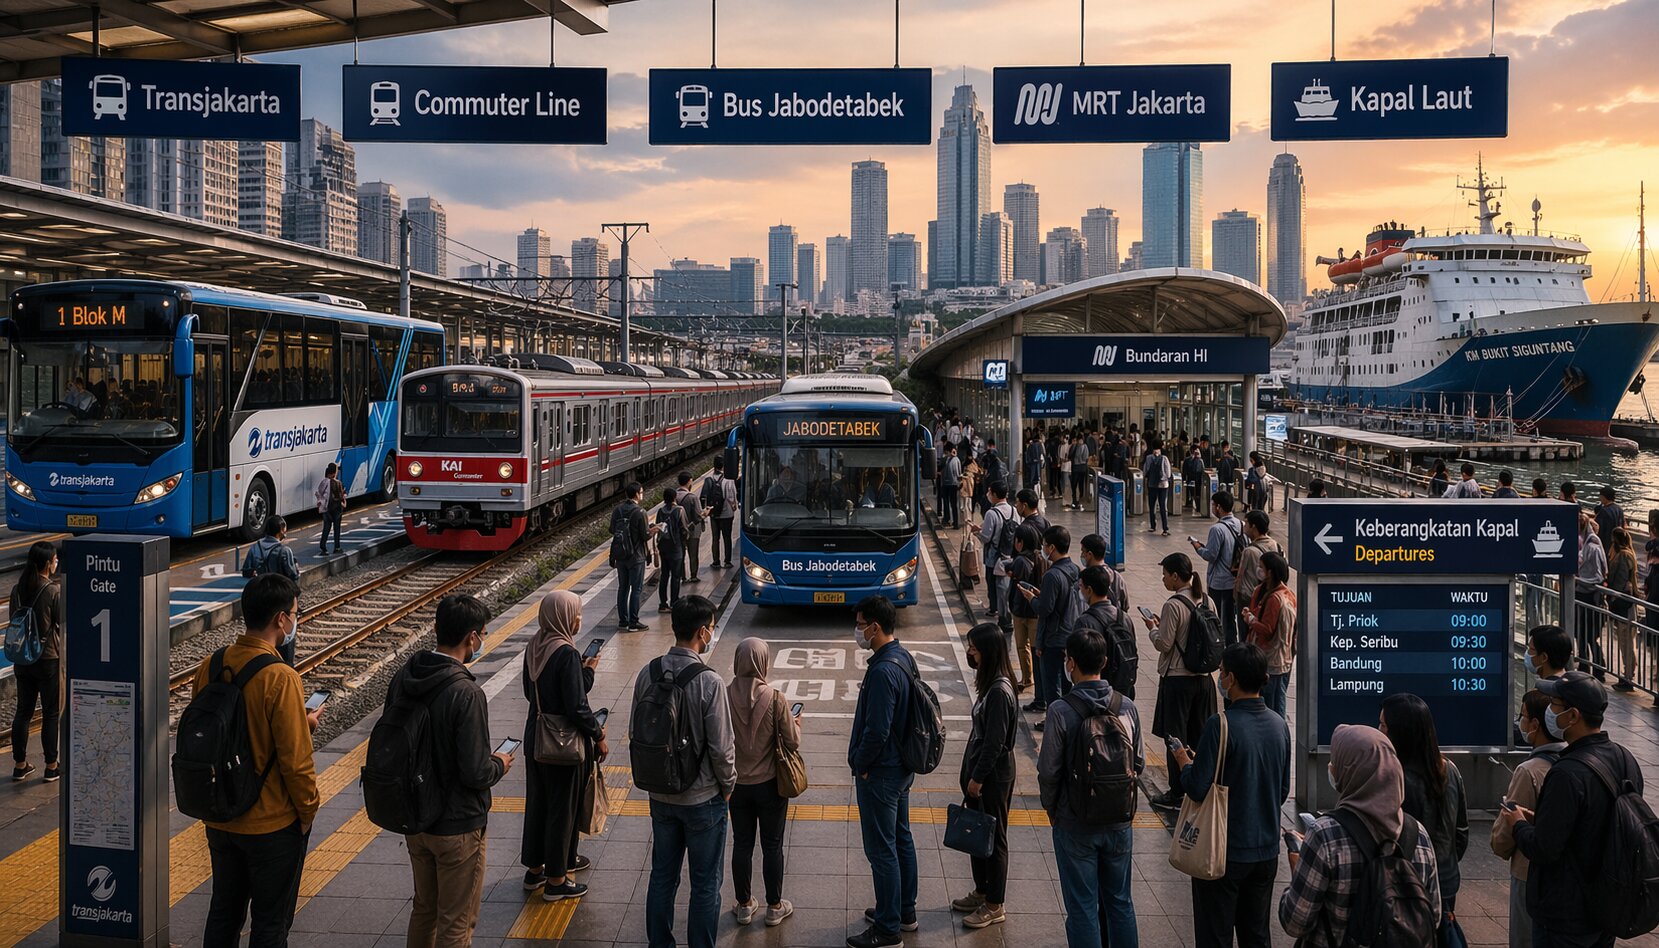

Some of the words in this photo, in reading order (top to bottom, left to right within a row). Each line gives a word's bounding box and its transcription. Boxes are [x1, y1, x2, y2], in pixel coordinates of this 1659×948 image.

[141, 84, 281, 118] Transjakarta
[414, 89, 528, 117] Commuter
[535, 91, 581, 117] Line
[723, 92, 763, 117] Bus
[767, 91, 905, 118] Jabodetabek
[1073, 90, 1121, 115] MRT
[1126, 89, 1206, 115] Jakarta
[1351, 84, 1415, 118] Kapal
[1422, 84, 1473, 110] Laut
[58, 306, 66, 326] 1
[72, 305, 107, 326] Blok
[112, 305, 126, 325] M
[1126, 348, 1190, 363] Bundaran
[1194, 348, 1208, 363] HI
[1481, 346, 1509, 360] BUKIT
[1511, 340, 1576, 358] SIGUNTANG
[265, 424, 327, 451] transjakarta
[783, 421, 880, 436] JABODETABEK
[441, 460, 463, 472] KAI
[60, 474, 115, 488] transjakarta
[1355, 518, 1471, 542] Keberangkatan
[1476, 518, 1519, 542] Kapal
[86, 554, 121, 573] Pintu
[1355, 544, 1435, 566] Departures
[782, 559, 803, 571] Bus
[805, 559, 877, 572] Jabodetabek
[90, 577, 117, 594] Gate
[1330, 591, 1372, 603] TUJUAN
[1450, 591, 1488, 603] WAKTU
[1330, 614, 1345, 631] Tj.
[1348, 613, 1379, 627] Priok
[1451, 614, 1487, 628] 09:00
[90, 608, 111, 663] 1
[1330, 635, 1357, 651] Kep.
[1360, 634, 1399, 649] Seribu
[1450, 635, 1487, 649] 09:30
[1330, 656, 1382, 673] Bandung
[1451, 656, 1487, 670] 10:00
[1330, 677, 1384, 694] Lampung
[1451, 677, 1486, 691] 10:30
[72, 904, 133, 923] transjakarta
